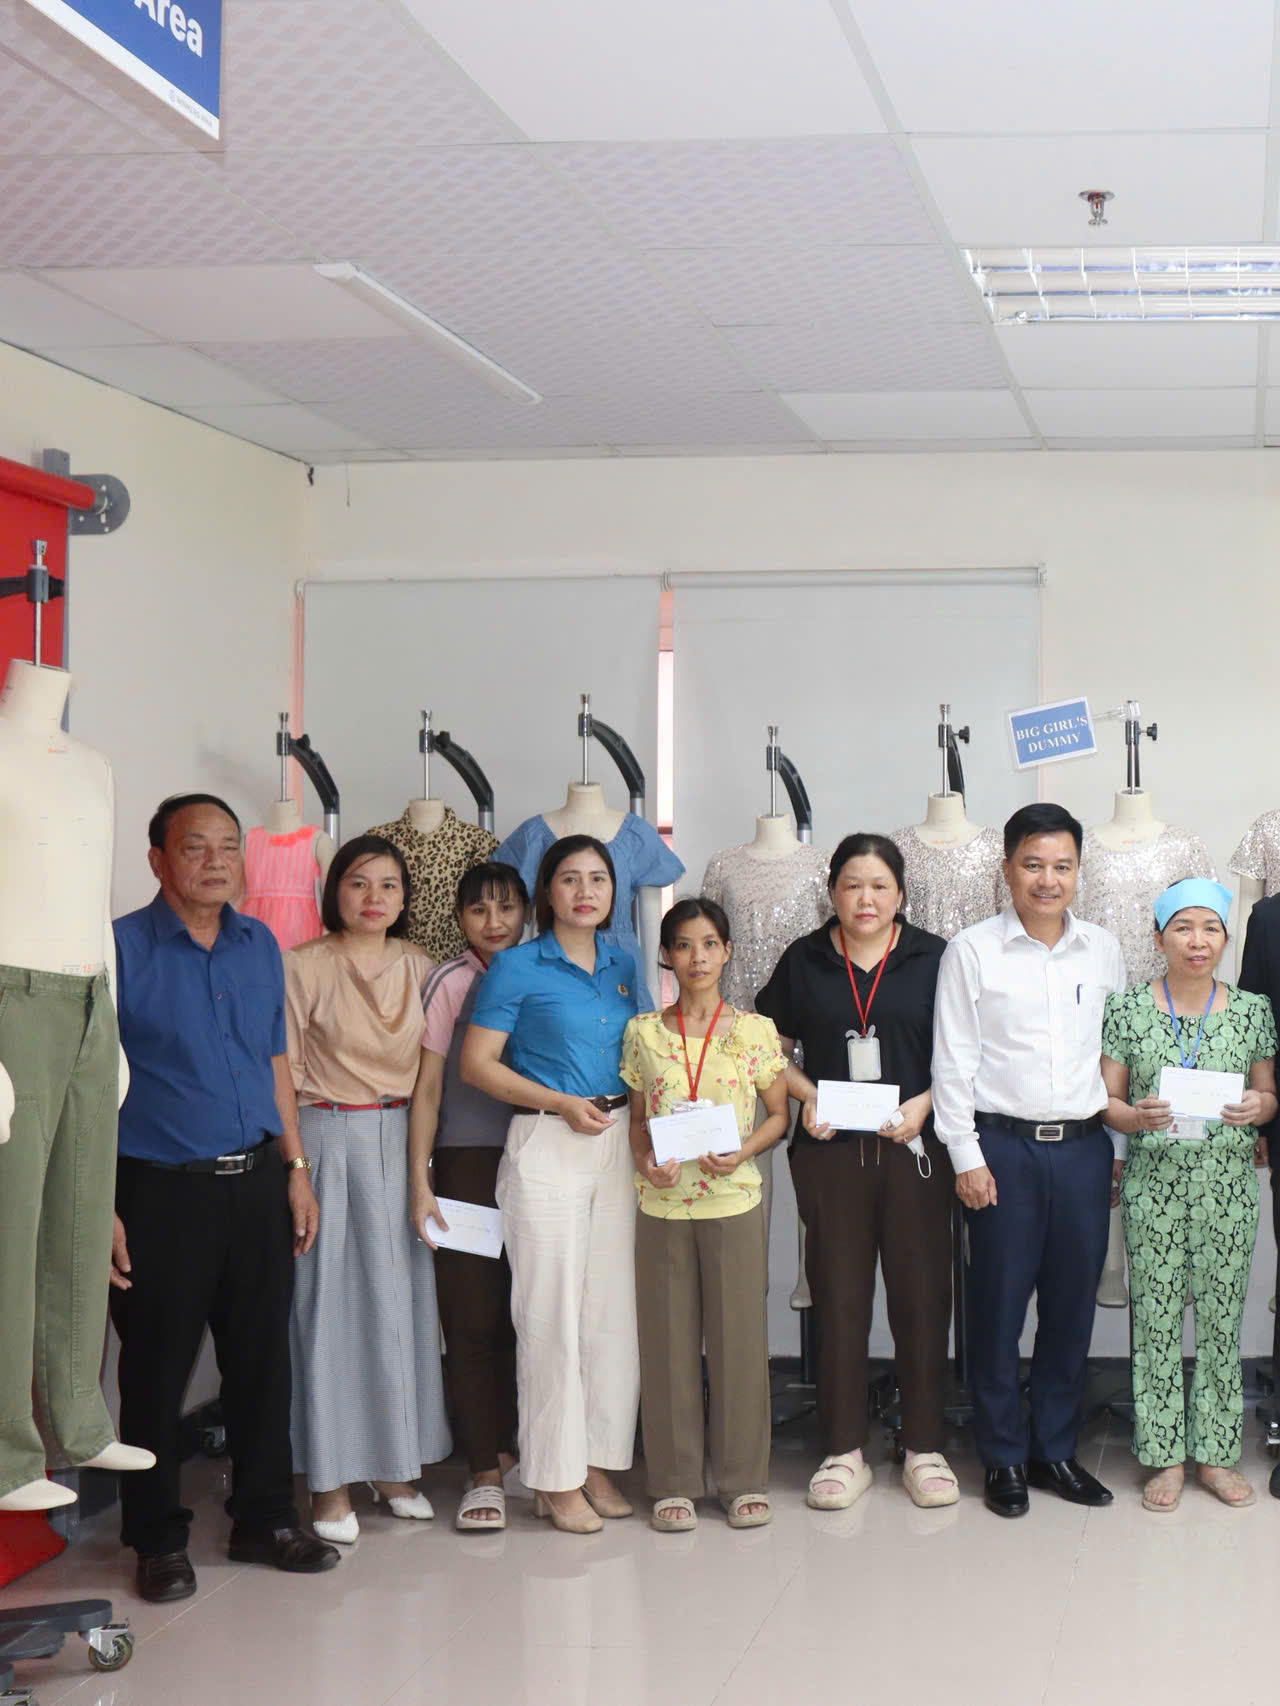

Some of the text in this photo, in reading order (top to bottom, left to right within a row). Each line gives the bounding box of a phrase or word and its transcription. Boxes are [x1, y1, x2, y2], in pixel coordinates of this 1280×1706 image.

[1017, 715, 1088, 741] BIG GIRL'S
[1028, 731, 1081, 753] DUMMY
